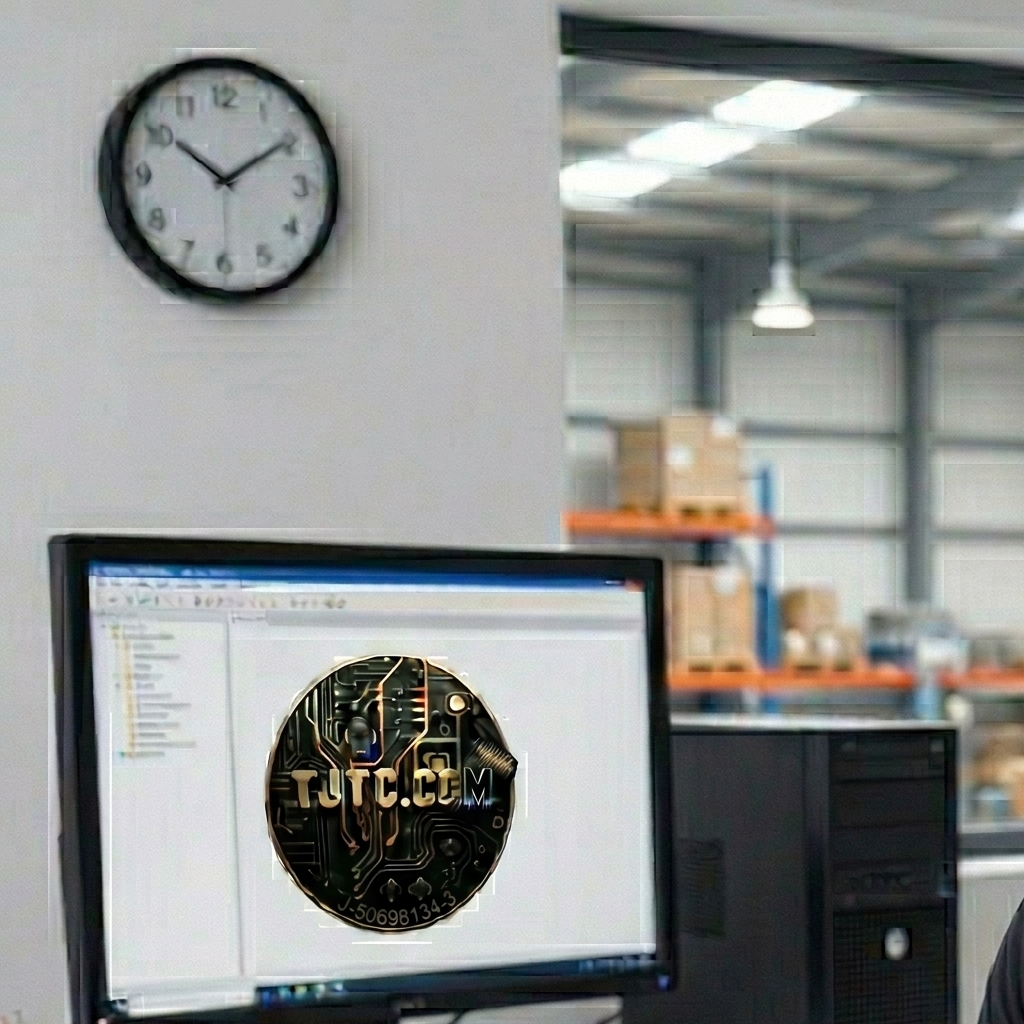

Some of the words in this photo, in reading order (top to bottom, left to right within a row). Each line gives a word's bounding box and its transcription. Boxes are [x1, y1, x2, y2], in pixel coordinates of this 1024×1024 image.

[212, 84, 239, 108] 12
[216, 252, 233, 274] 6
[337, 889, 457, 926] J-50698134-3
